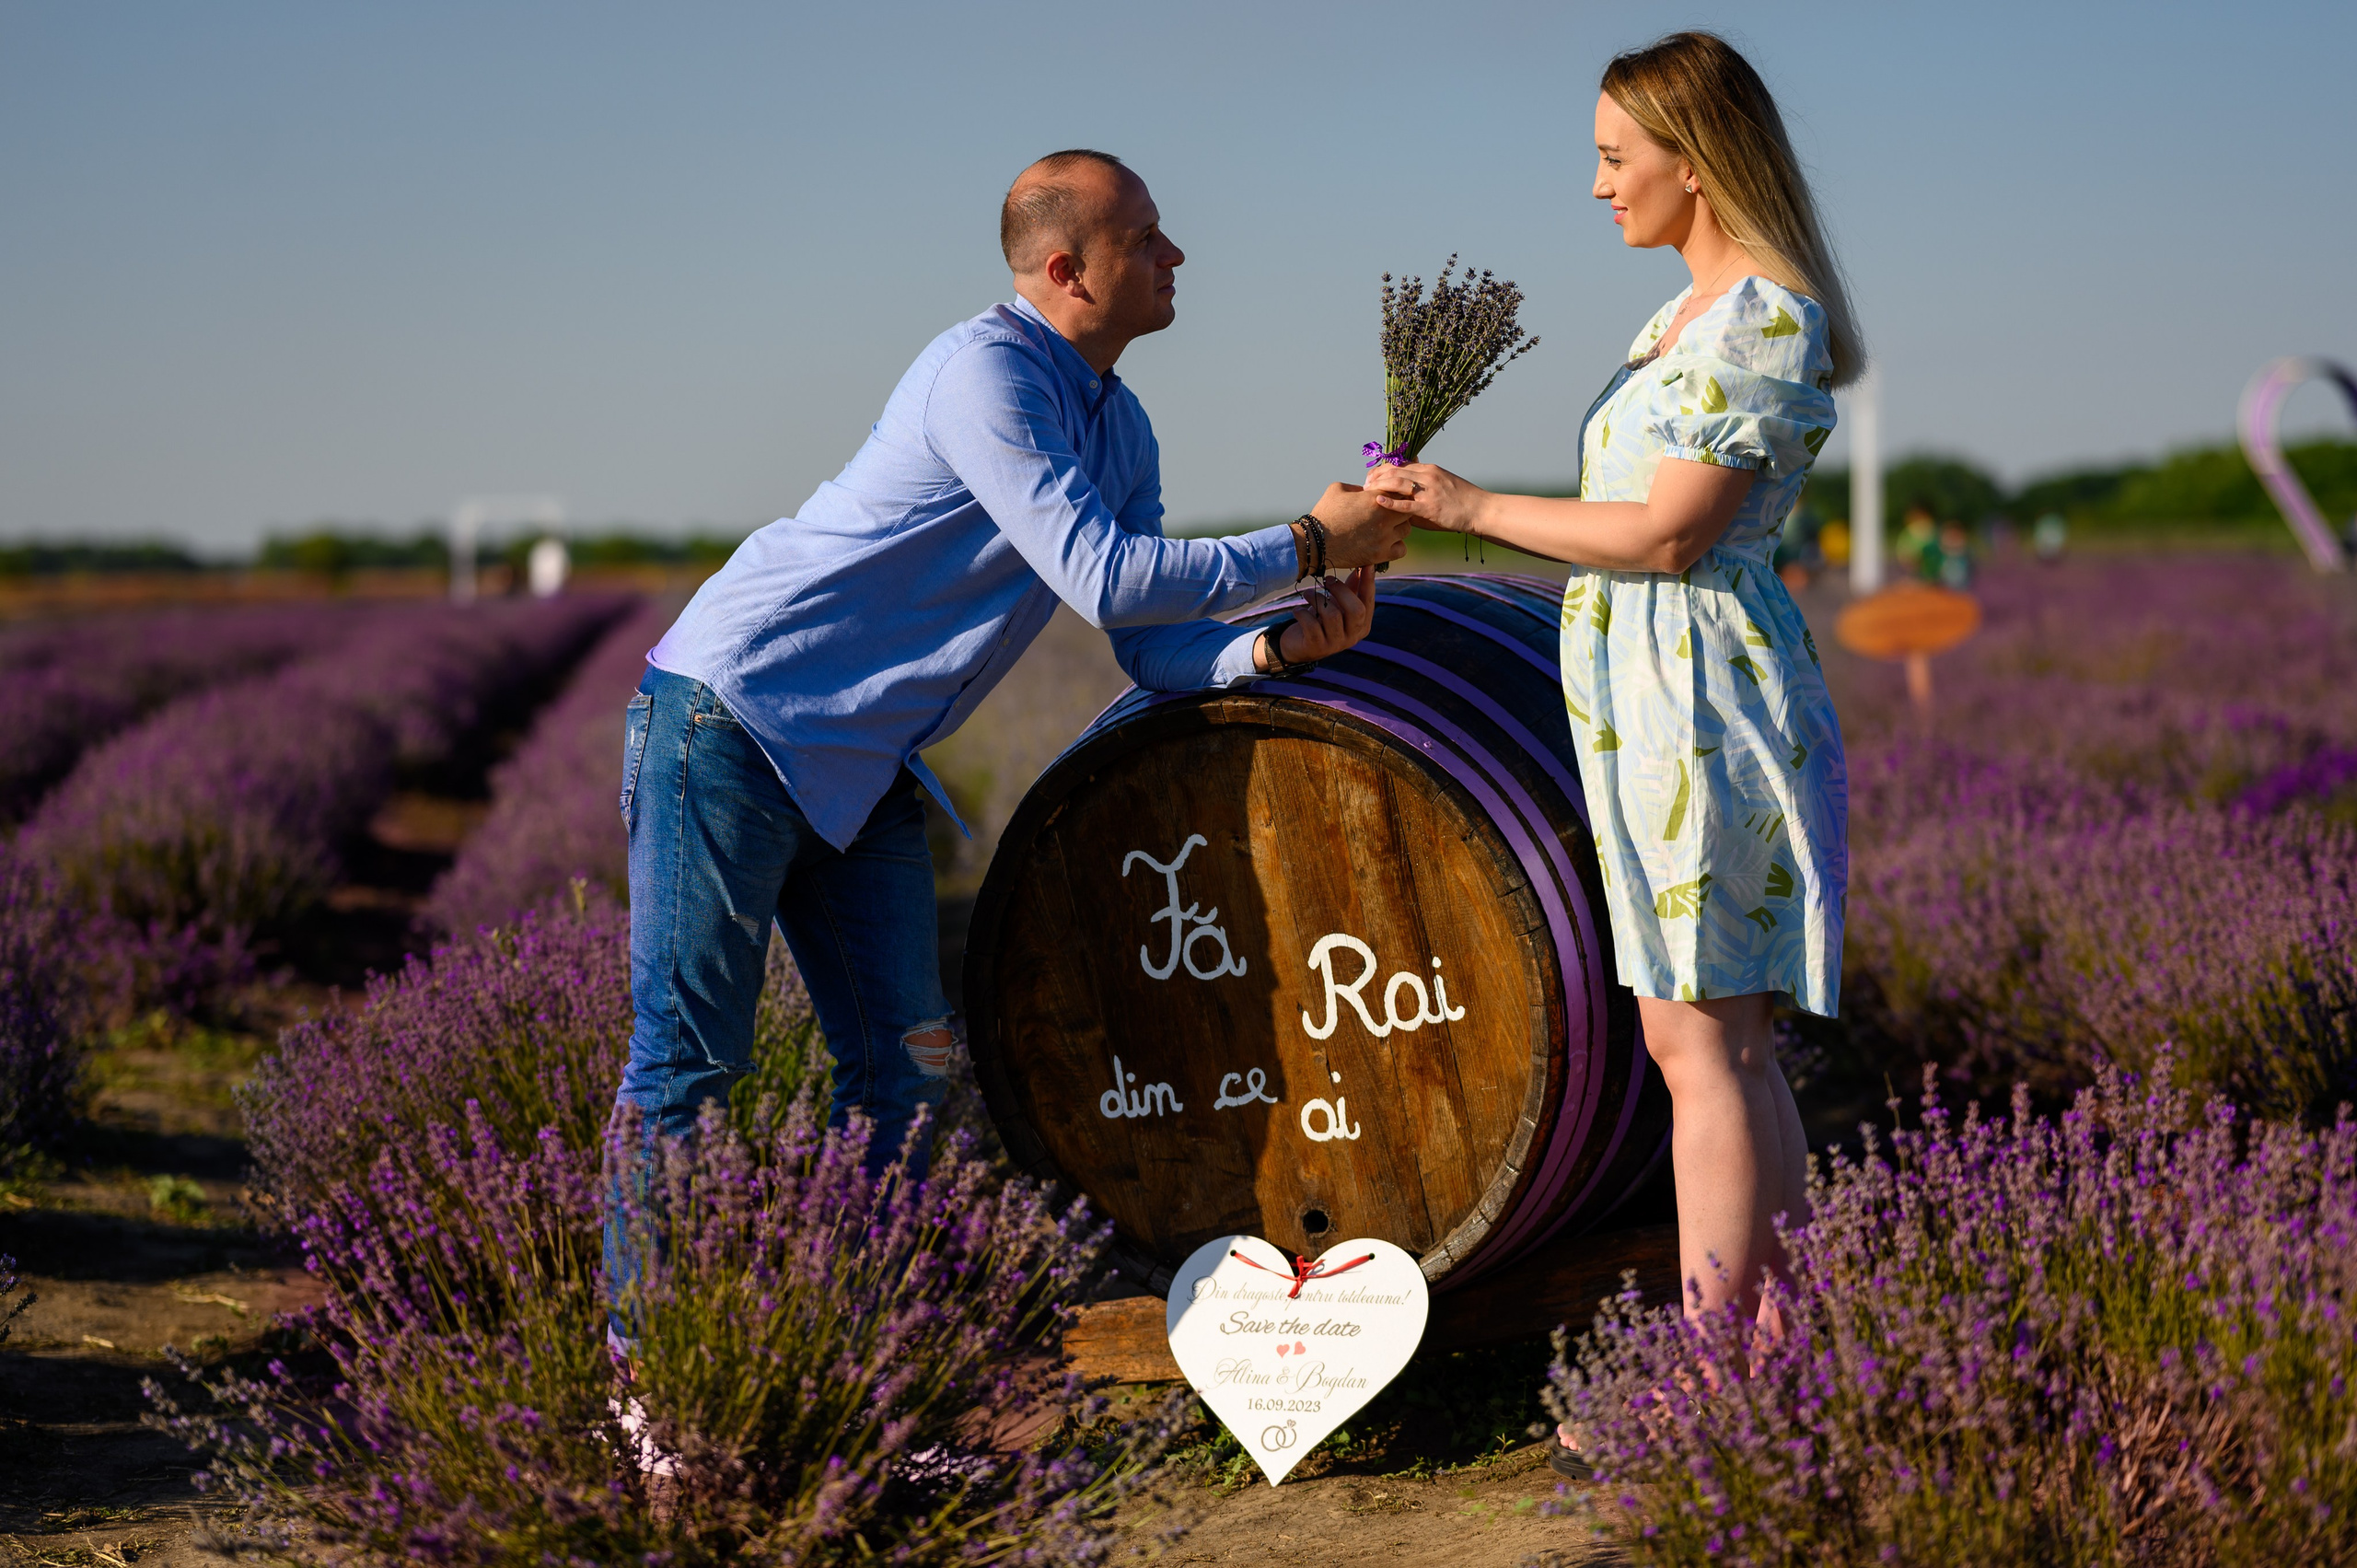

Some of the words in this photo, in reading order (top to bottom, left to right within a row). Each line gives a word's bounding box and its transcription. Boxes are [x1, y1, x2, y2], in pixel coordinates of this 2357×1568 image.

[1302, 933, 1465, 1040] Rai
[1213, 1067, 1278, 1110] ce
[1300, 1071, 1361, 1142] ai
[1187, 1275, 1228, 1305] Din
[1337, 1285, 1411, 1306] totdeauna!
[1219, 1310, 1275, 1335] Save
[1278, 1317, 1310, 1336] the
[1313, 1318, 1362, 1337] date
[1206, 1357, 1271, 1389] Alina
[1276, 1366, 1295, 1385] &
[1285, 1361, 1369, 1400] Bogdan
[1247, 1397, 1321, 1413] 16.09.2023
